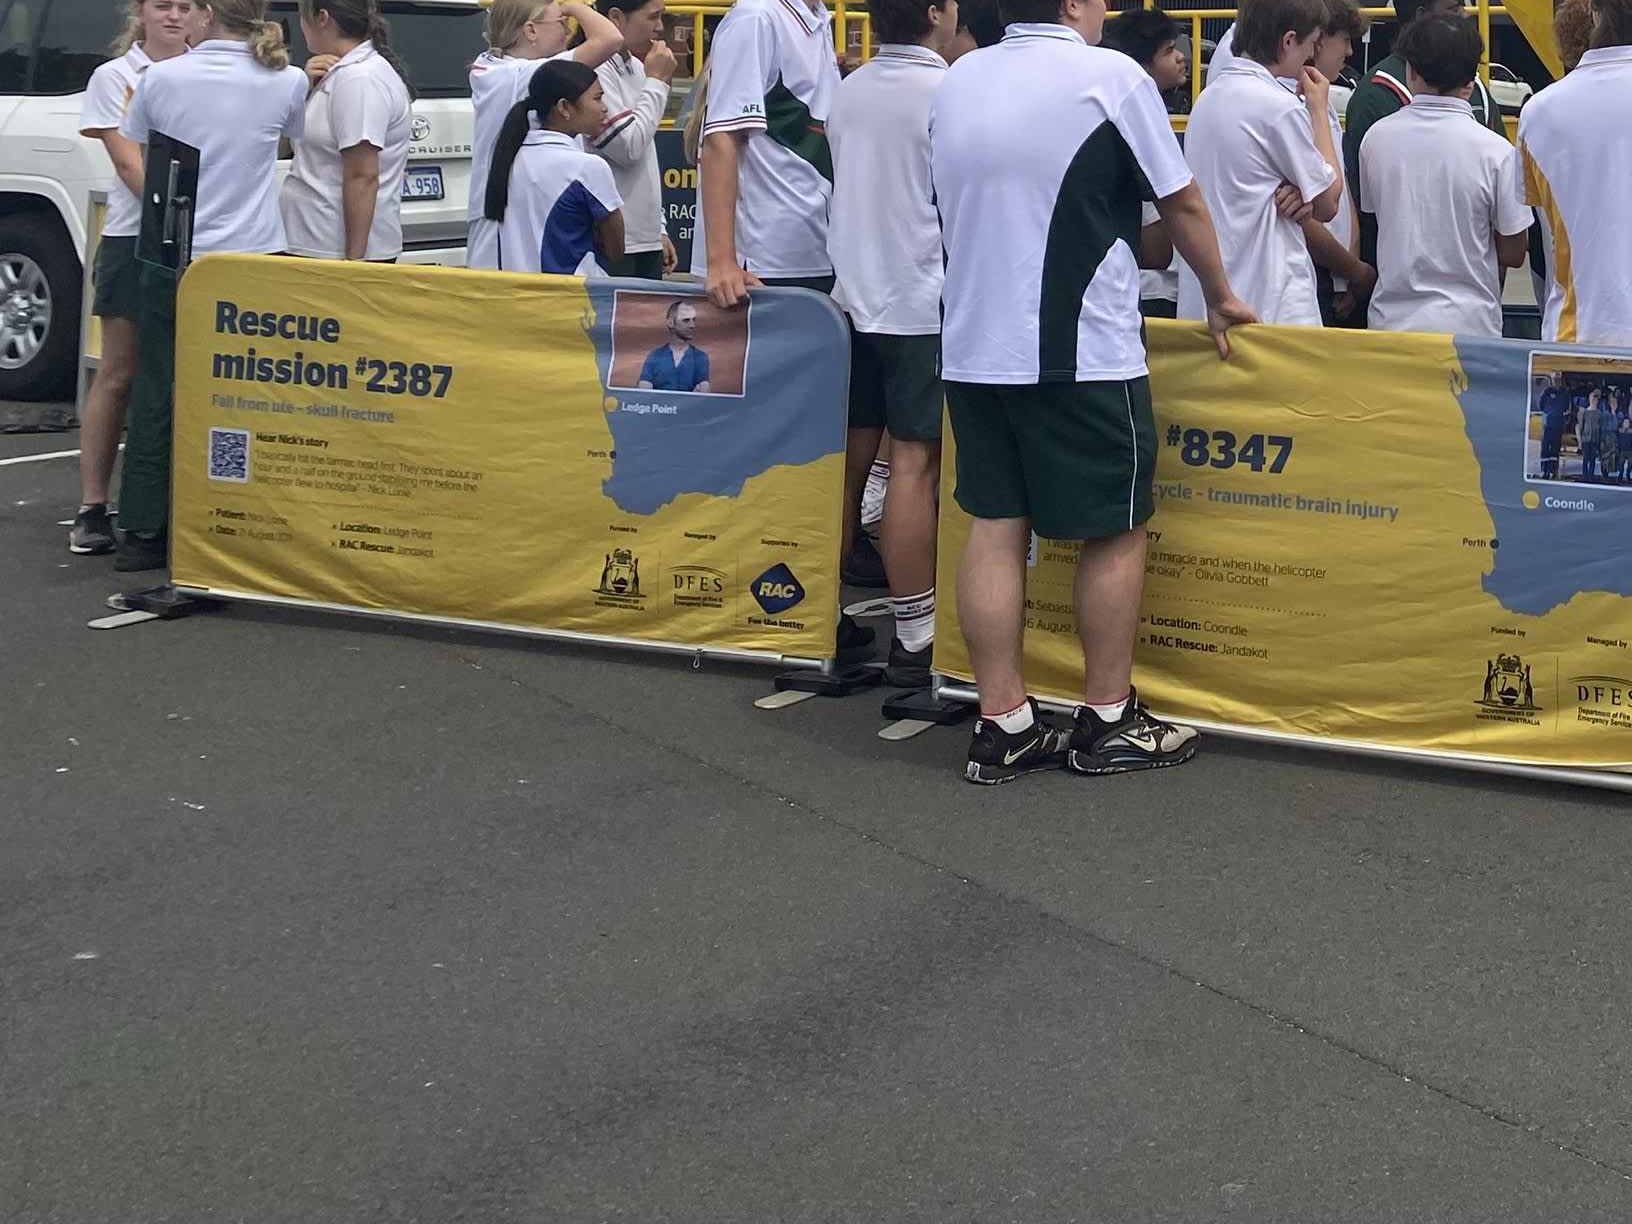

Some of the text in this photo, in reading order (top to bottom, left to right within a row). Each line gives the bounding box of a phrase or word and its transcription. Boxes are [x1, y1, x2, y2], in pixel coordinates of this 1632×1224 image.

[742, 104, 762, 113] AFL
[408, 144, 471, 154] CRUISER
[215, 301, 340, 343] Rescue
[212, 348, 452, 398] mission #2387
[212, 394, 394, 423] Fall from ute skull fracture
[622, 402, 678, 415] Ledge Point
[305, 438, 328, 448] story
[1166, 424, 1292, 474] #8347
[1208, 487, 1292, 509] traumatic
[1296, 494, 1342, 515] brain
[1346, 498, 1398, 522] injury
[1544, 496, 1595, 511] Coondle
[339, 522, 382, 534] Location:
[339, 540, 358, 550] RAC
[1462, 537, 1486, 548] Perth
[1160, 550, 1197, 565] miracle
[1200, 556, 1219, 568] and
[1223, 558, 1251, 571] when
[1253, 560, 1272, 573] the
[1274, 563, 1328, 580] helicopter
[674, 574, 722, 592] DFES
[1195, 566, 1224, 582] Olivia
[1226, 572, 1269, 588] Gobbett
[759, 582, 796, 599] RAC
[1150, 614, 1248, 636] Location: Coondle
[1490, 626, 1526, 638] Funded by
[1150, 636, 1268, 660] RAC Rescue: Jandakot
[1586, 636, 1627, 649] Managed by
